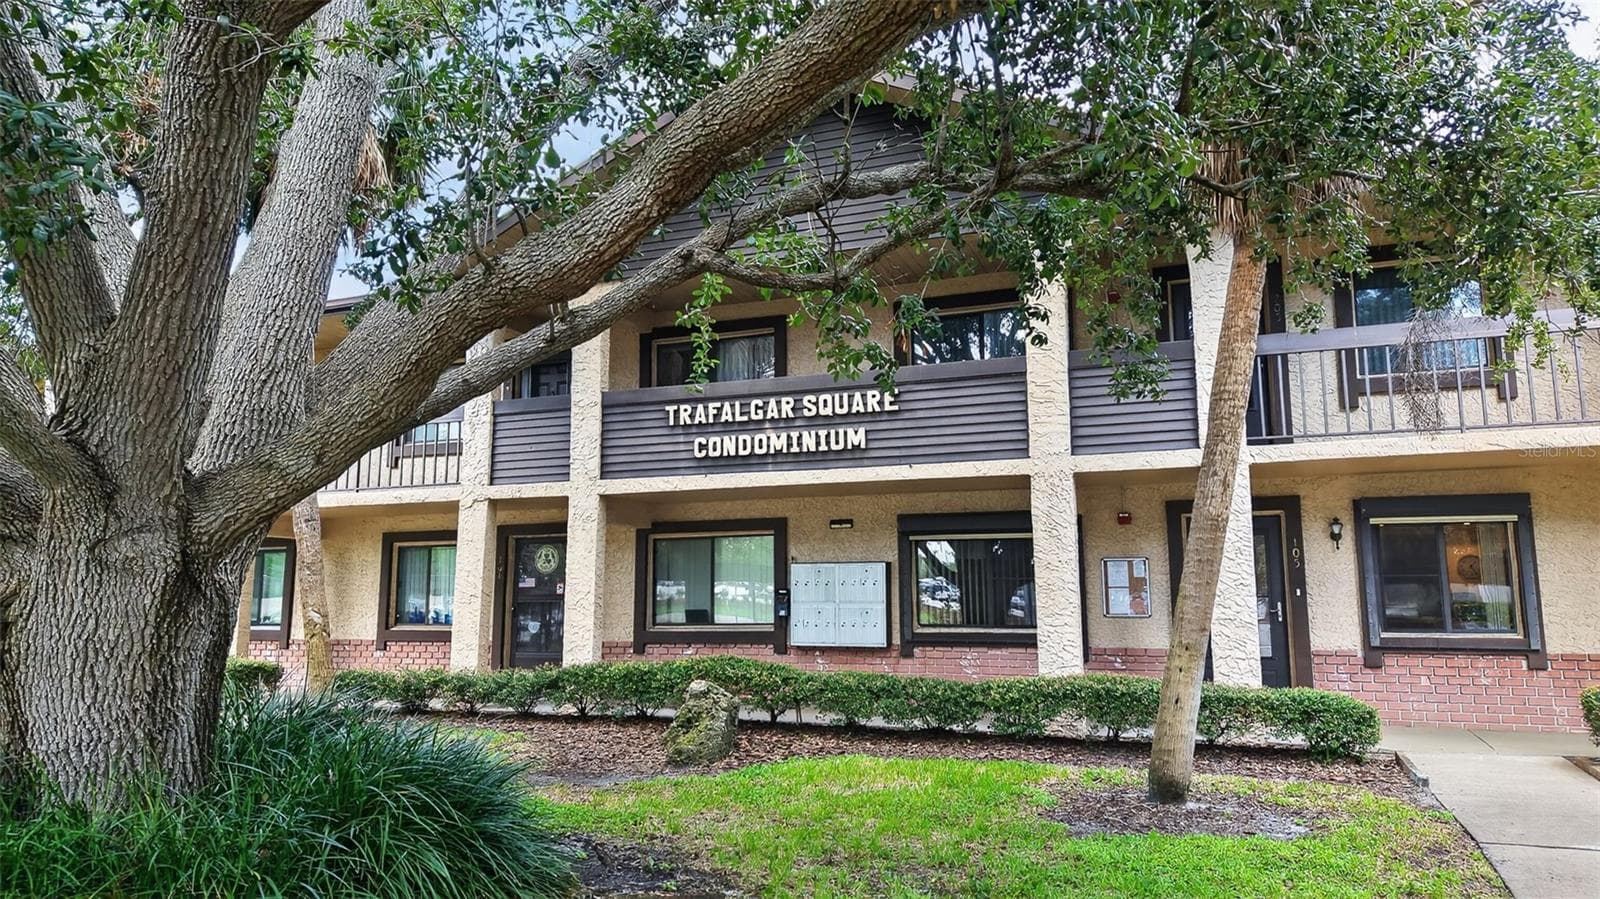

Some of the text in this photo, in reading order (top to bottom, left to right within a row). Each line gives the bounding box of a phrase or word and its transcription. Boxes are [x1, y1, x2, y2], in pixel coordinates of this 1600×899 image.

[665, 388, 899, 426] TRAFALGAR SQUARE
[693, 427, 866, 458] CONDOMINIUM
